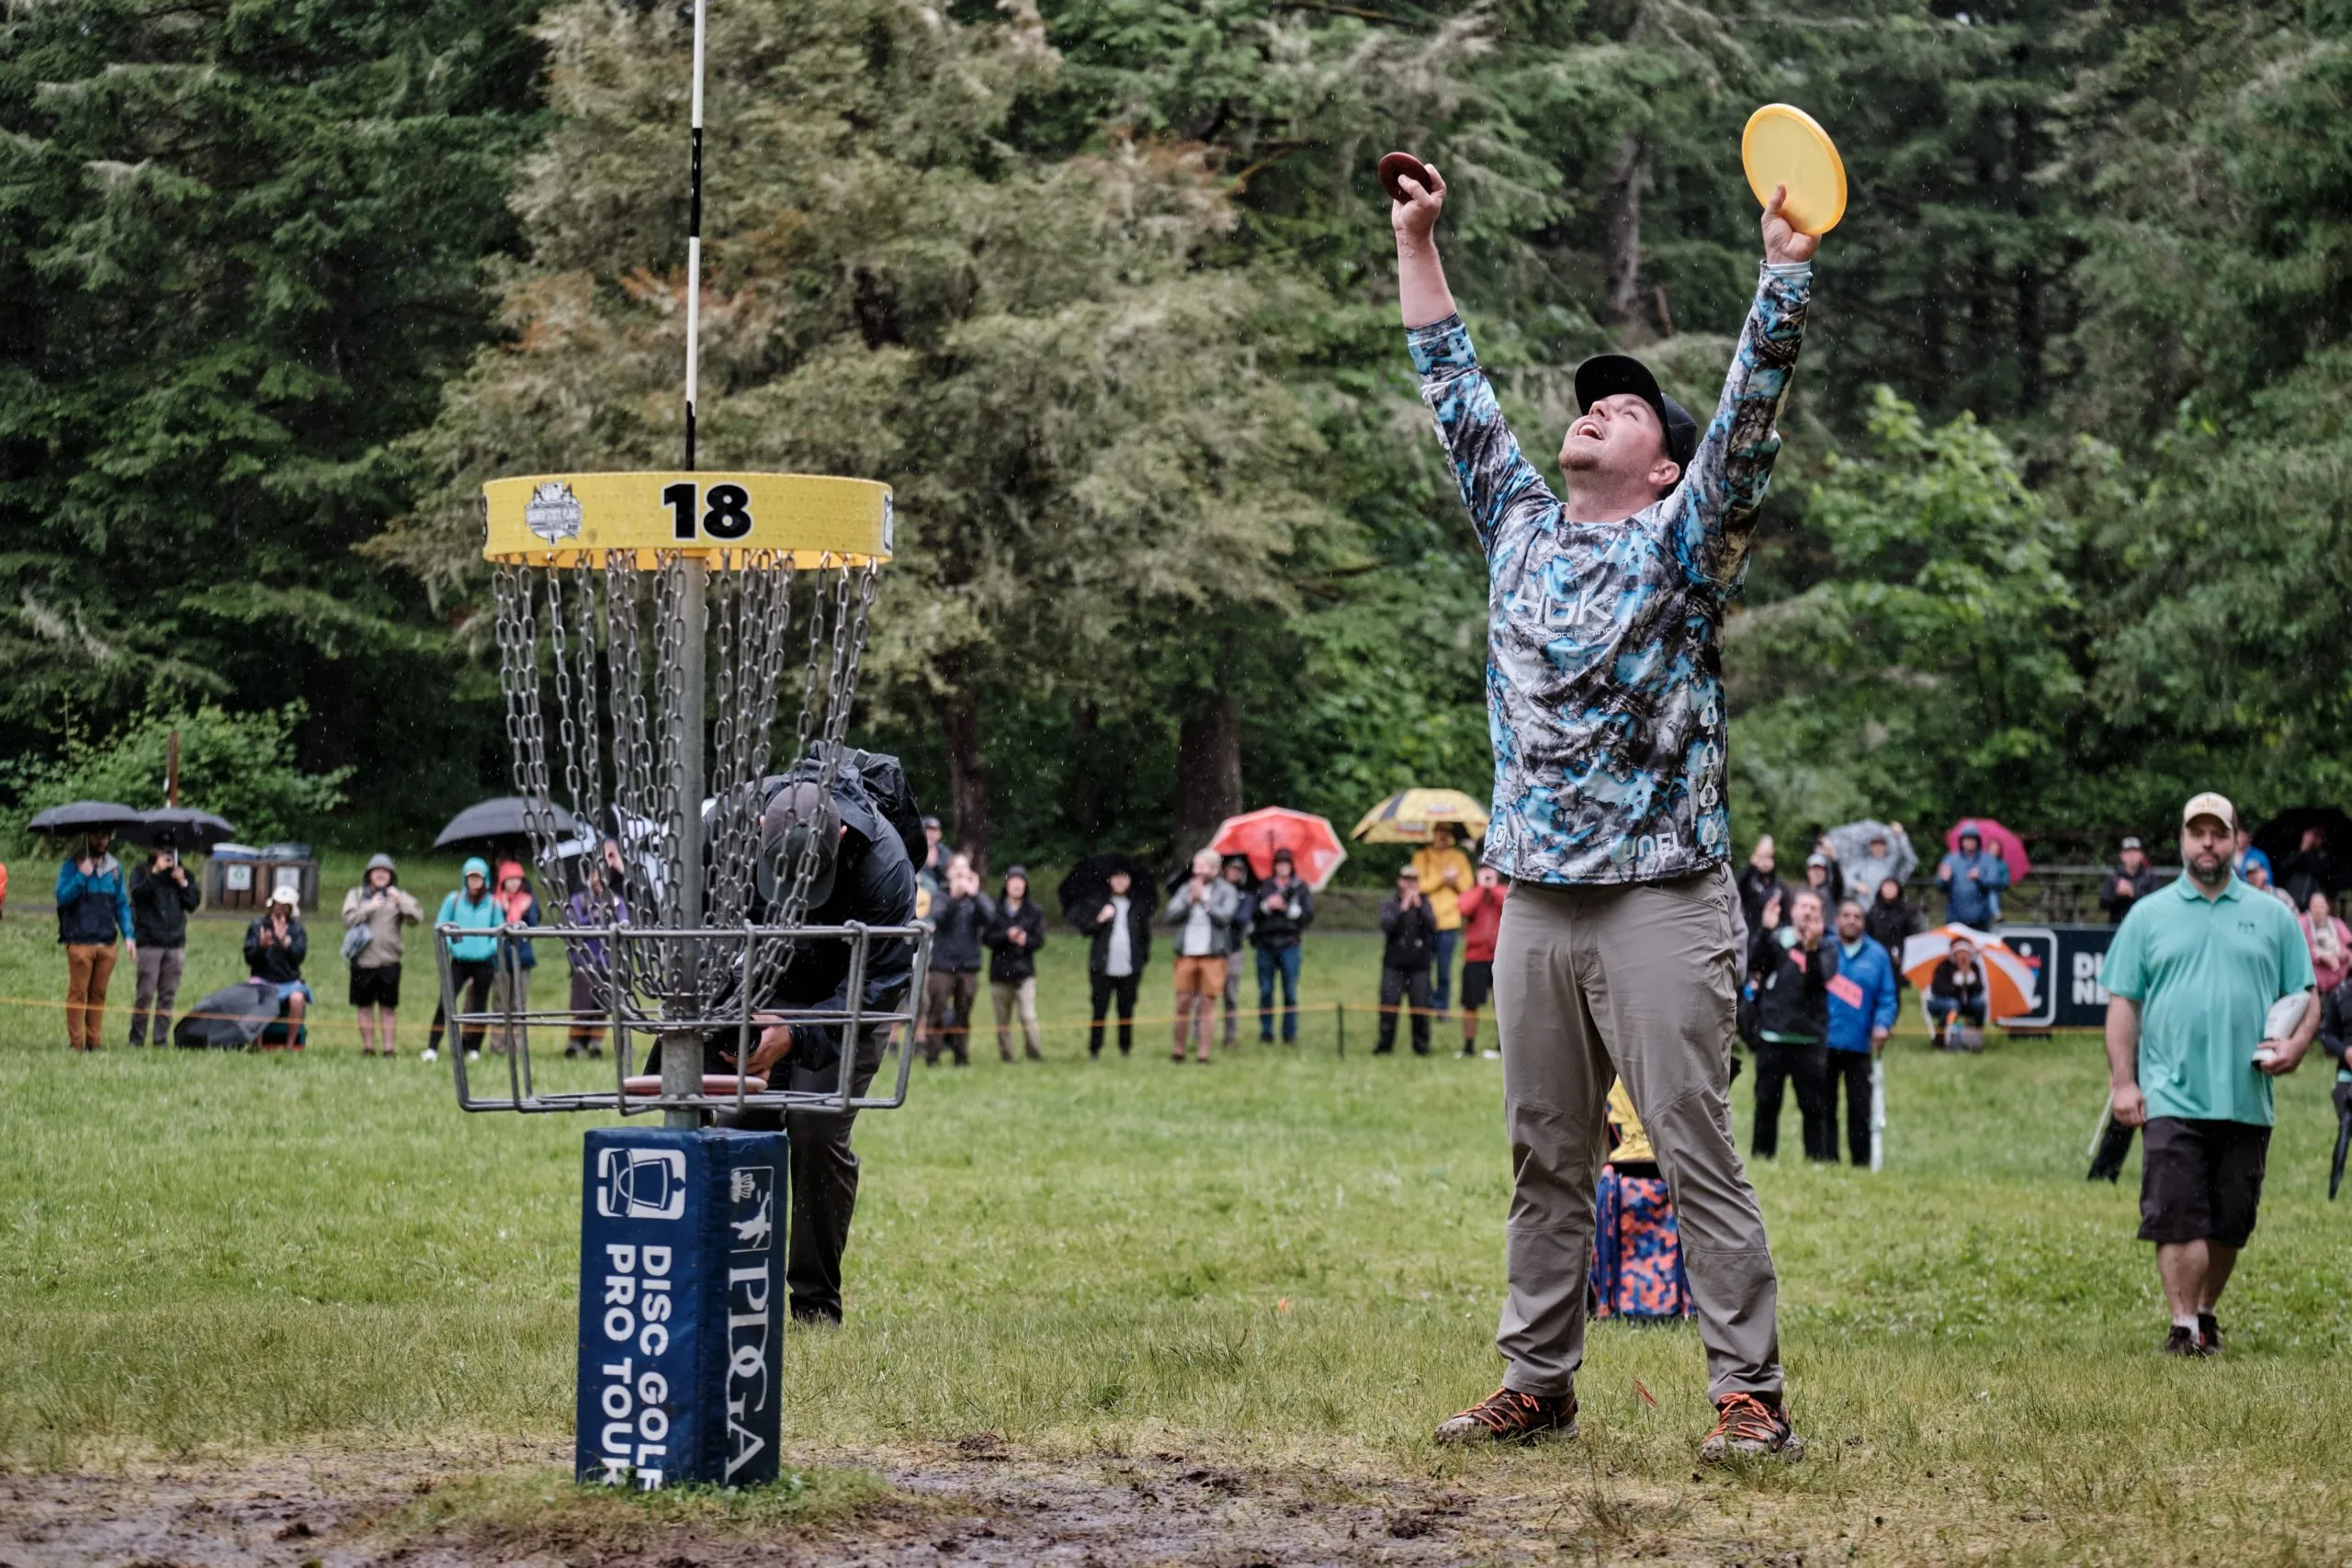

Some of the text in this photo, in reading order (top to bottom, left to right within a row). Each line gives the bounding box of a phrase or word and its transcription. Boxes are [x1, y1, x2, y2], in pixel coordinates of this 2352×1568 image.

[662, 482, 753, 540] 18
[2073, 952, 2104, 977] DI
[2073, 979, 2110, 1005] NE
[602, 1244, 636, 1485] PRO TOUR
[636, 1246, 672, 1491] DISC GOLF
[726, 1258, 770, 1483] PDGA
